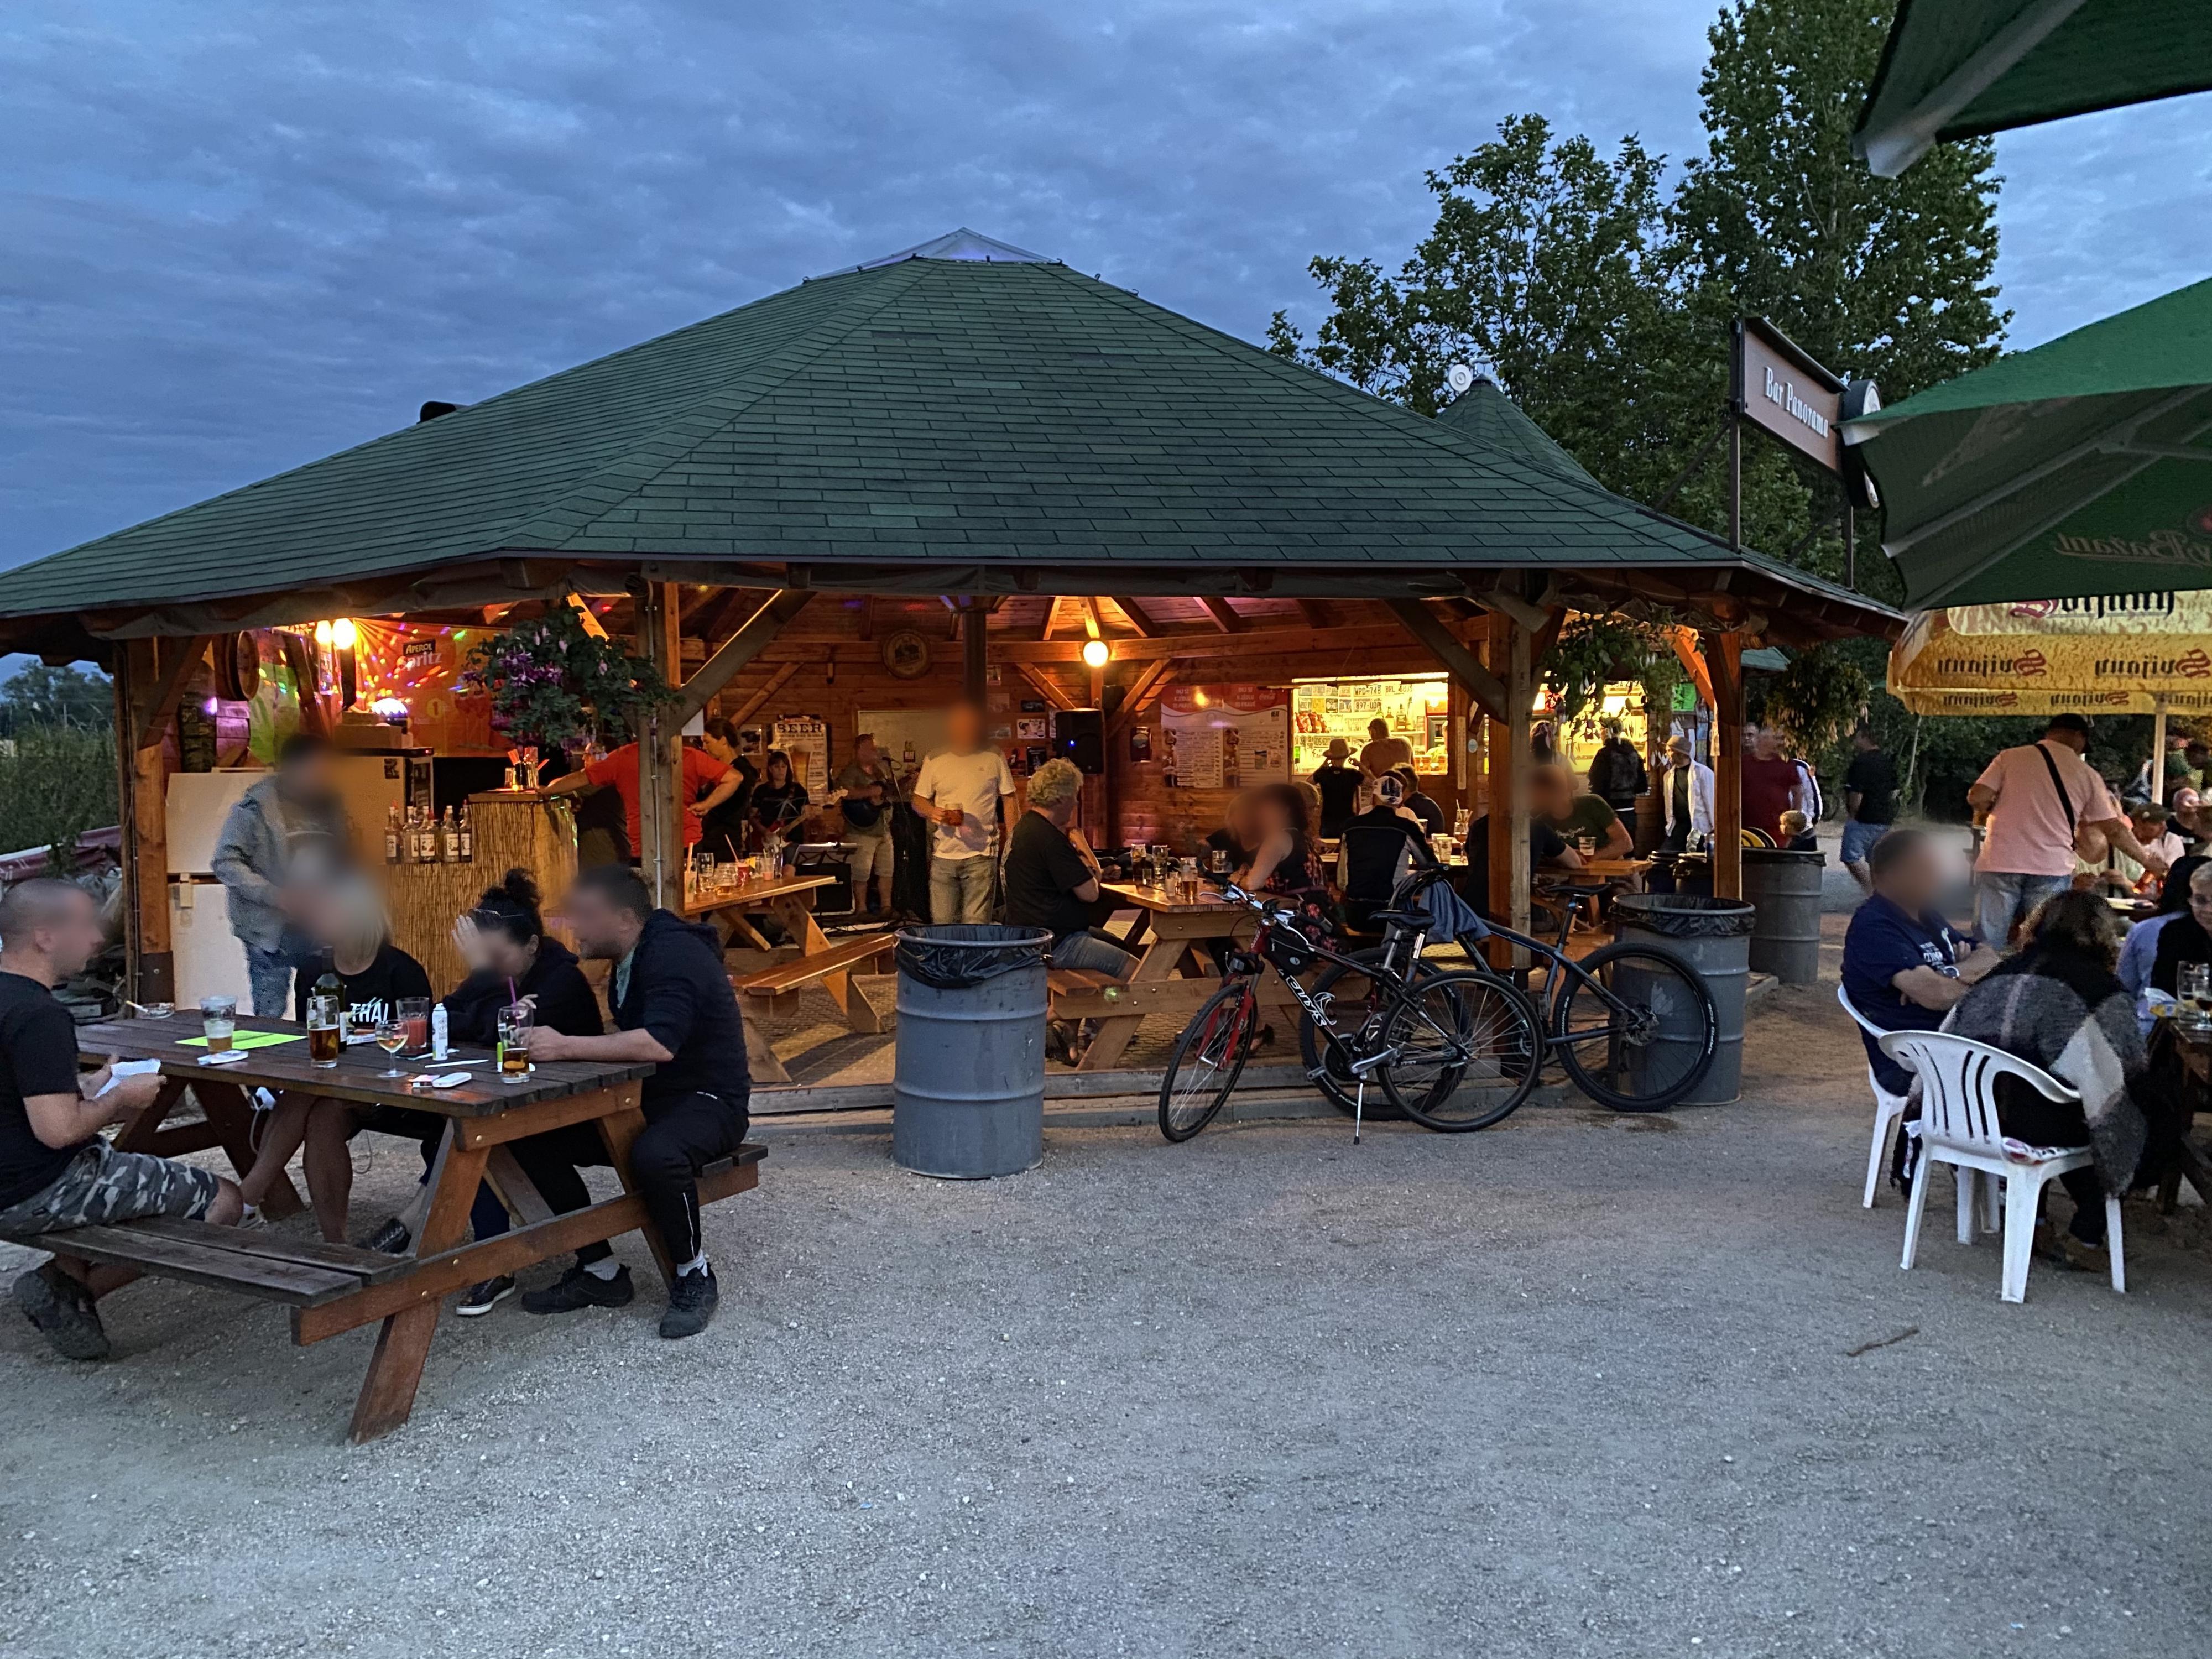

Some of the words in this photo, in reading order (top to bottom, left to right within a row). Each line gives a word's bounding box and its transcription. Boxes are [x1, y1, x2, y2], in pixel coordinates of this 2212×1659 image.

[1765, 367, 1783, 405] Bar
[1785, 382, 1828, 439] Panorama
[405, 643, 432, 654] APEROL
[350, 1002, 388, 1023] THAI
[1280, 971, 1327, 1026] ELLYS
